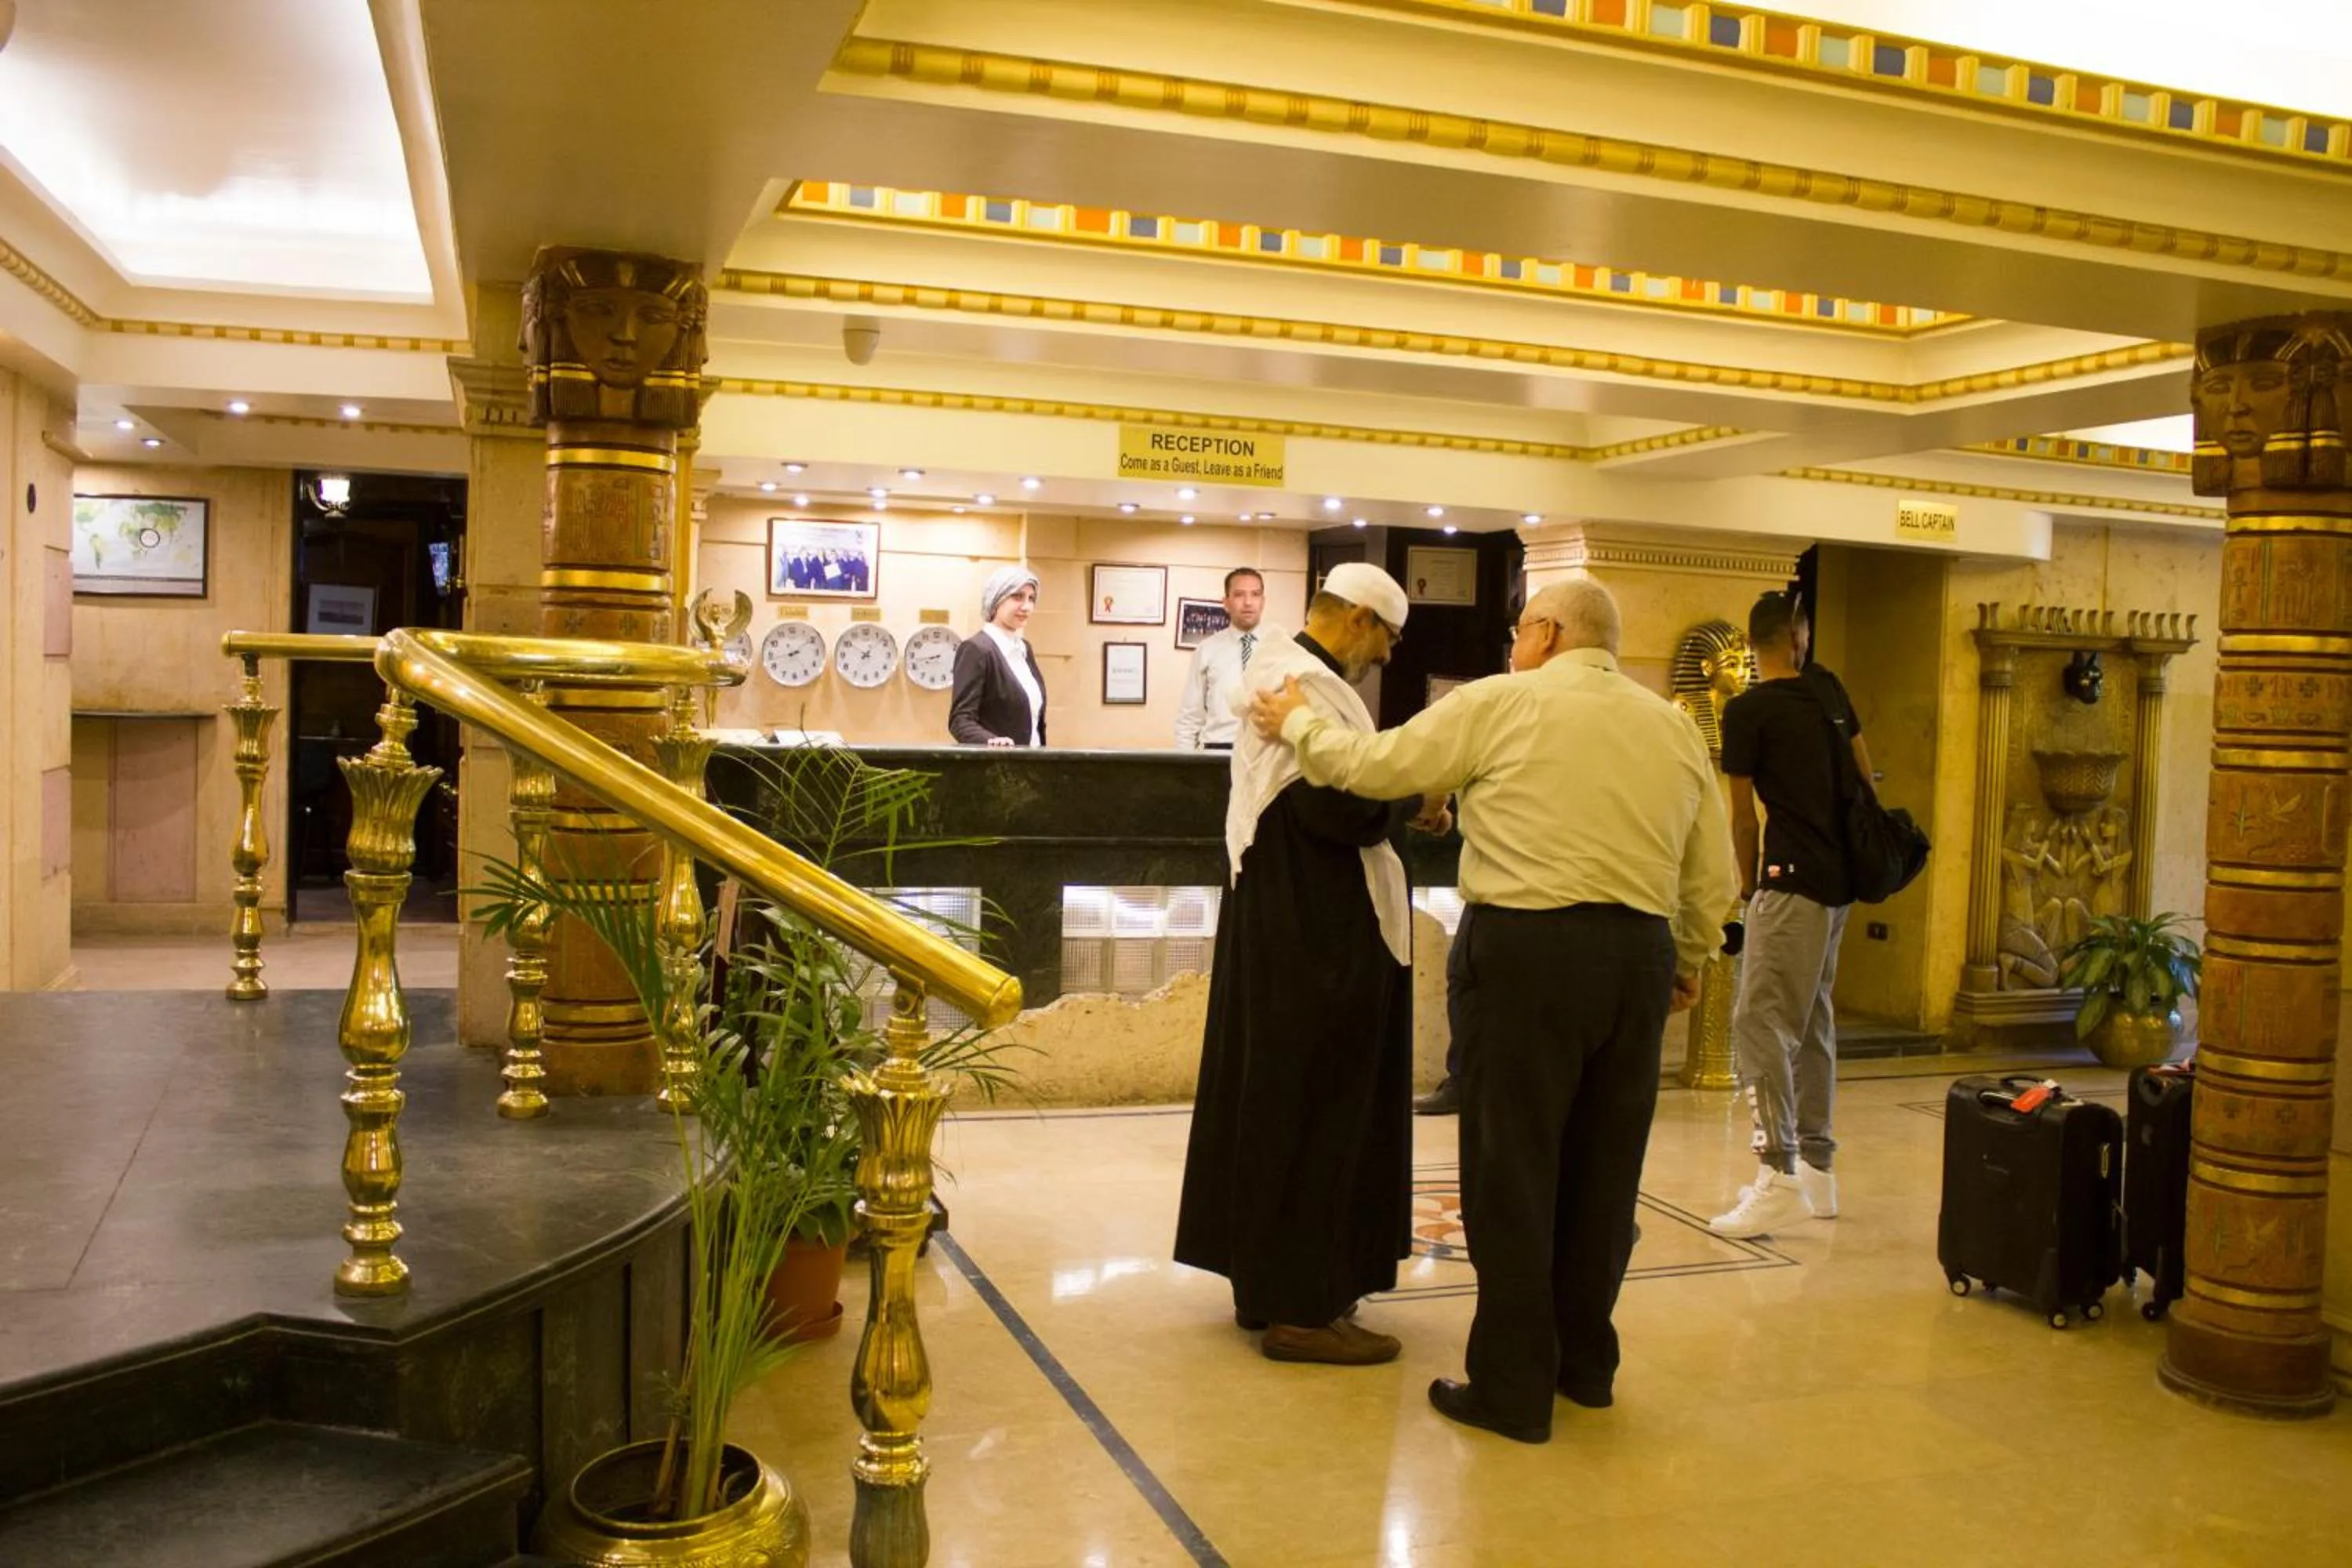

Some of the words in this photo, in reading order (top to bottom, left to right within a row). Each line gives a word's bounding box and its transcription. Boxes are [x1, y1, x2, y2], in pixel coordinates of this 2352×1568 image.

[1151, 434, 1254, 456] RECEPTION
[1120, 452, 1148, 470] Come
[1150, 459, 1160, 471] as
[1163, 460, 1169, 471] a
[1172, 456, 1201, 476] Guest,
[1204, 459, 1230, 476] Leave
[1233, 465, 1244, 477] as
[1246, 466, 1252, 477] a
[1254, 463, 1283, 480] Friend
[1900, 510, 1920, 528] BELL
[1922, 512, 1955, 532] CAPTAIN
